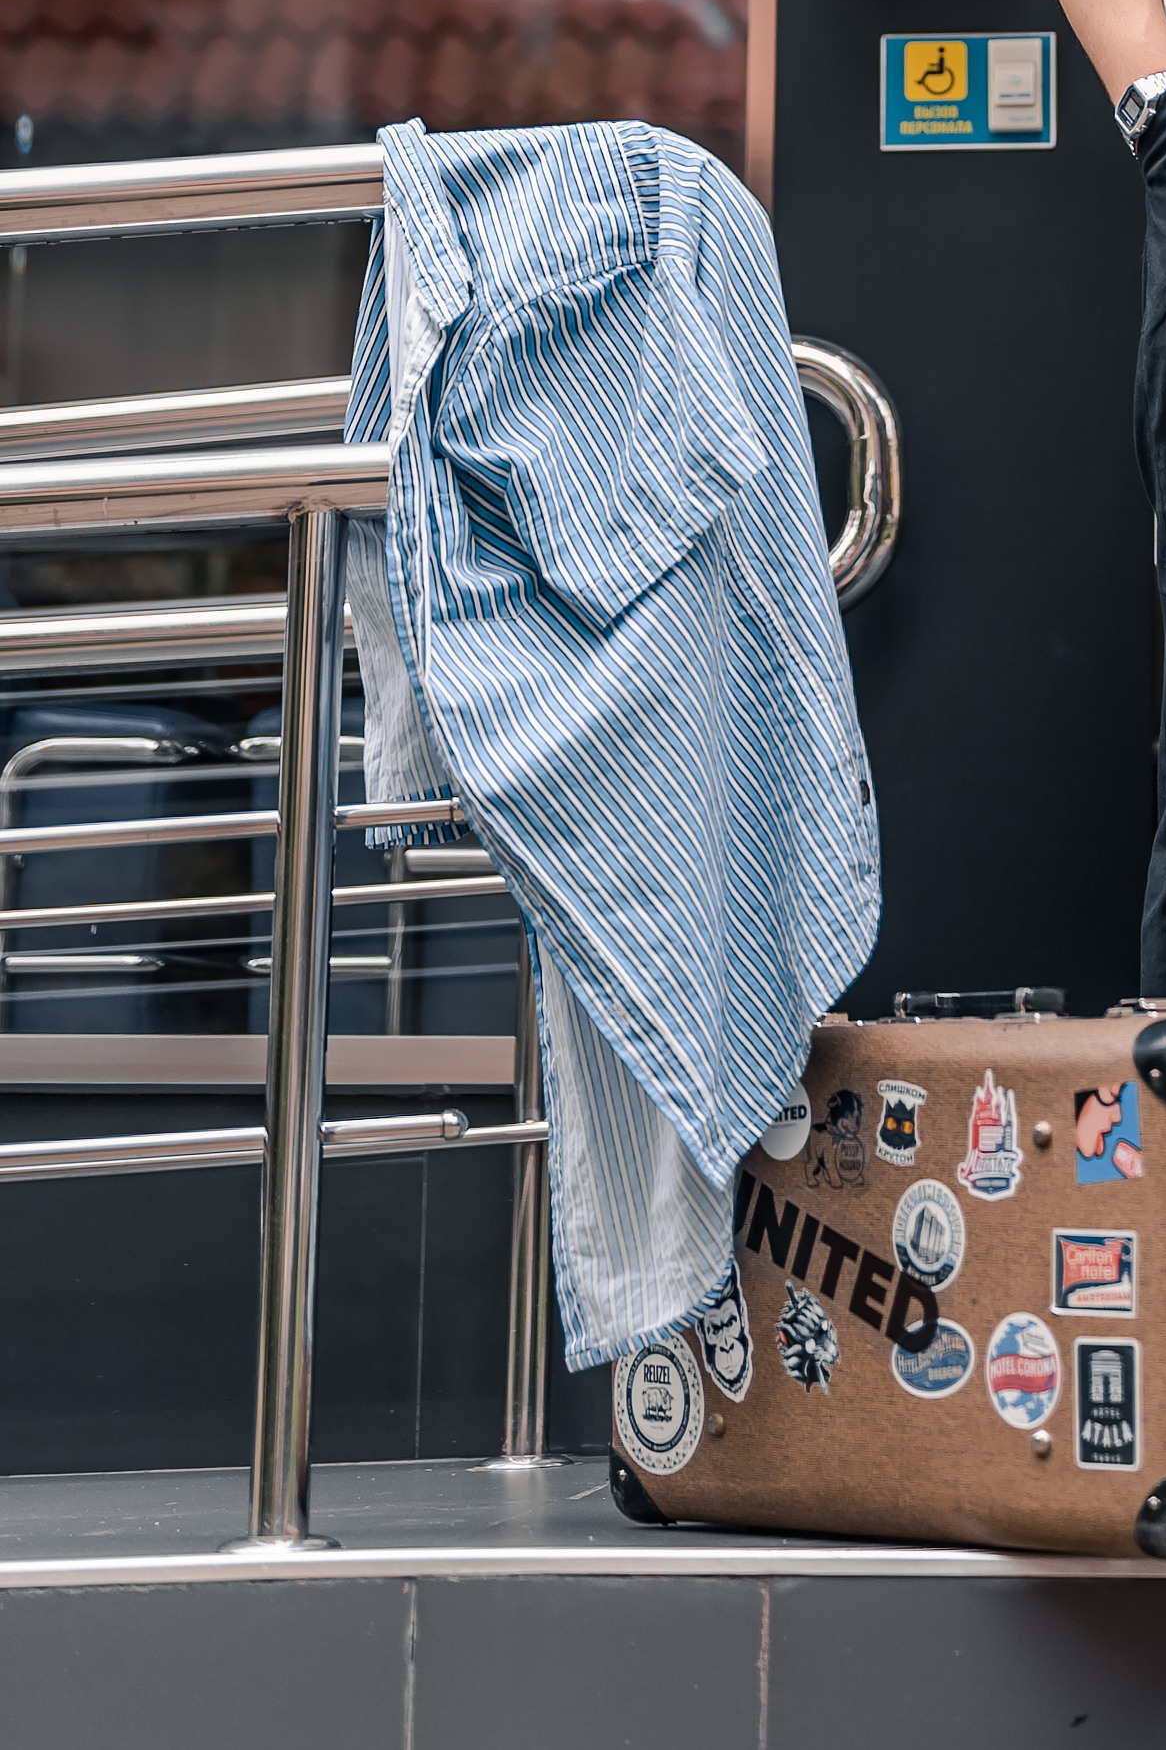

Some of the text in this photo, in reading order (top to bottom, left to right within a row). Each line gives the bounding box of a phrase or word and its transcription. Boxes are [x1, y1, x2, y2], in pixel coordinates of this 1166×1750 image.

[900, 120, 973, 134] ПЕРСОНАЛА
[879, 1082, 925, 1100] СЛИШКОМ
[774, 1104, 808, 1123] ITED
[643, 1364, 671, 1385] REUZEL
